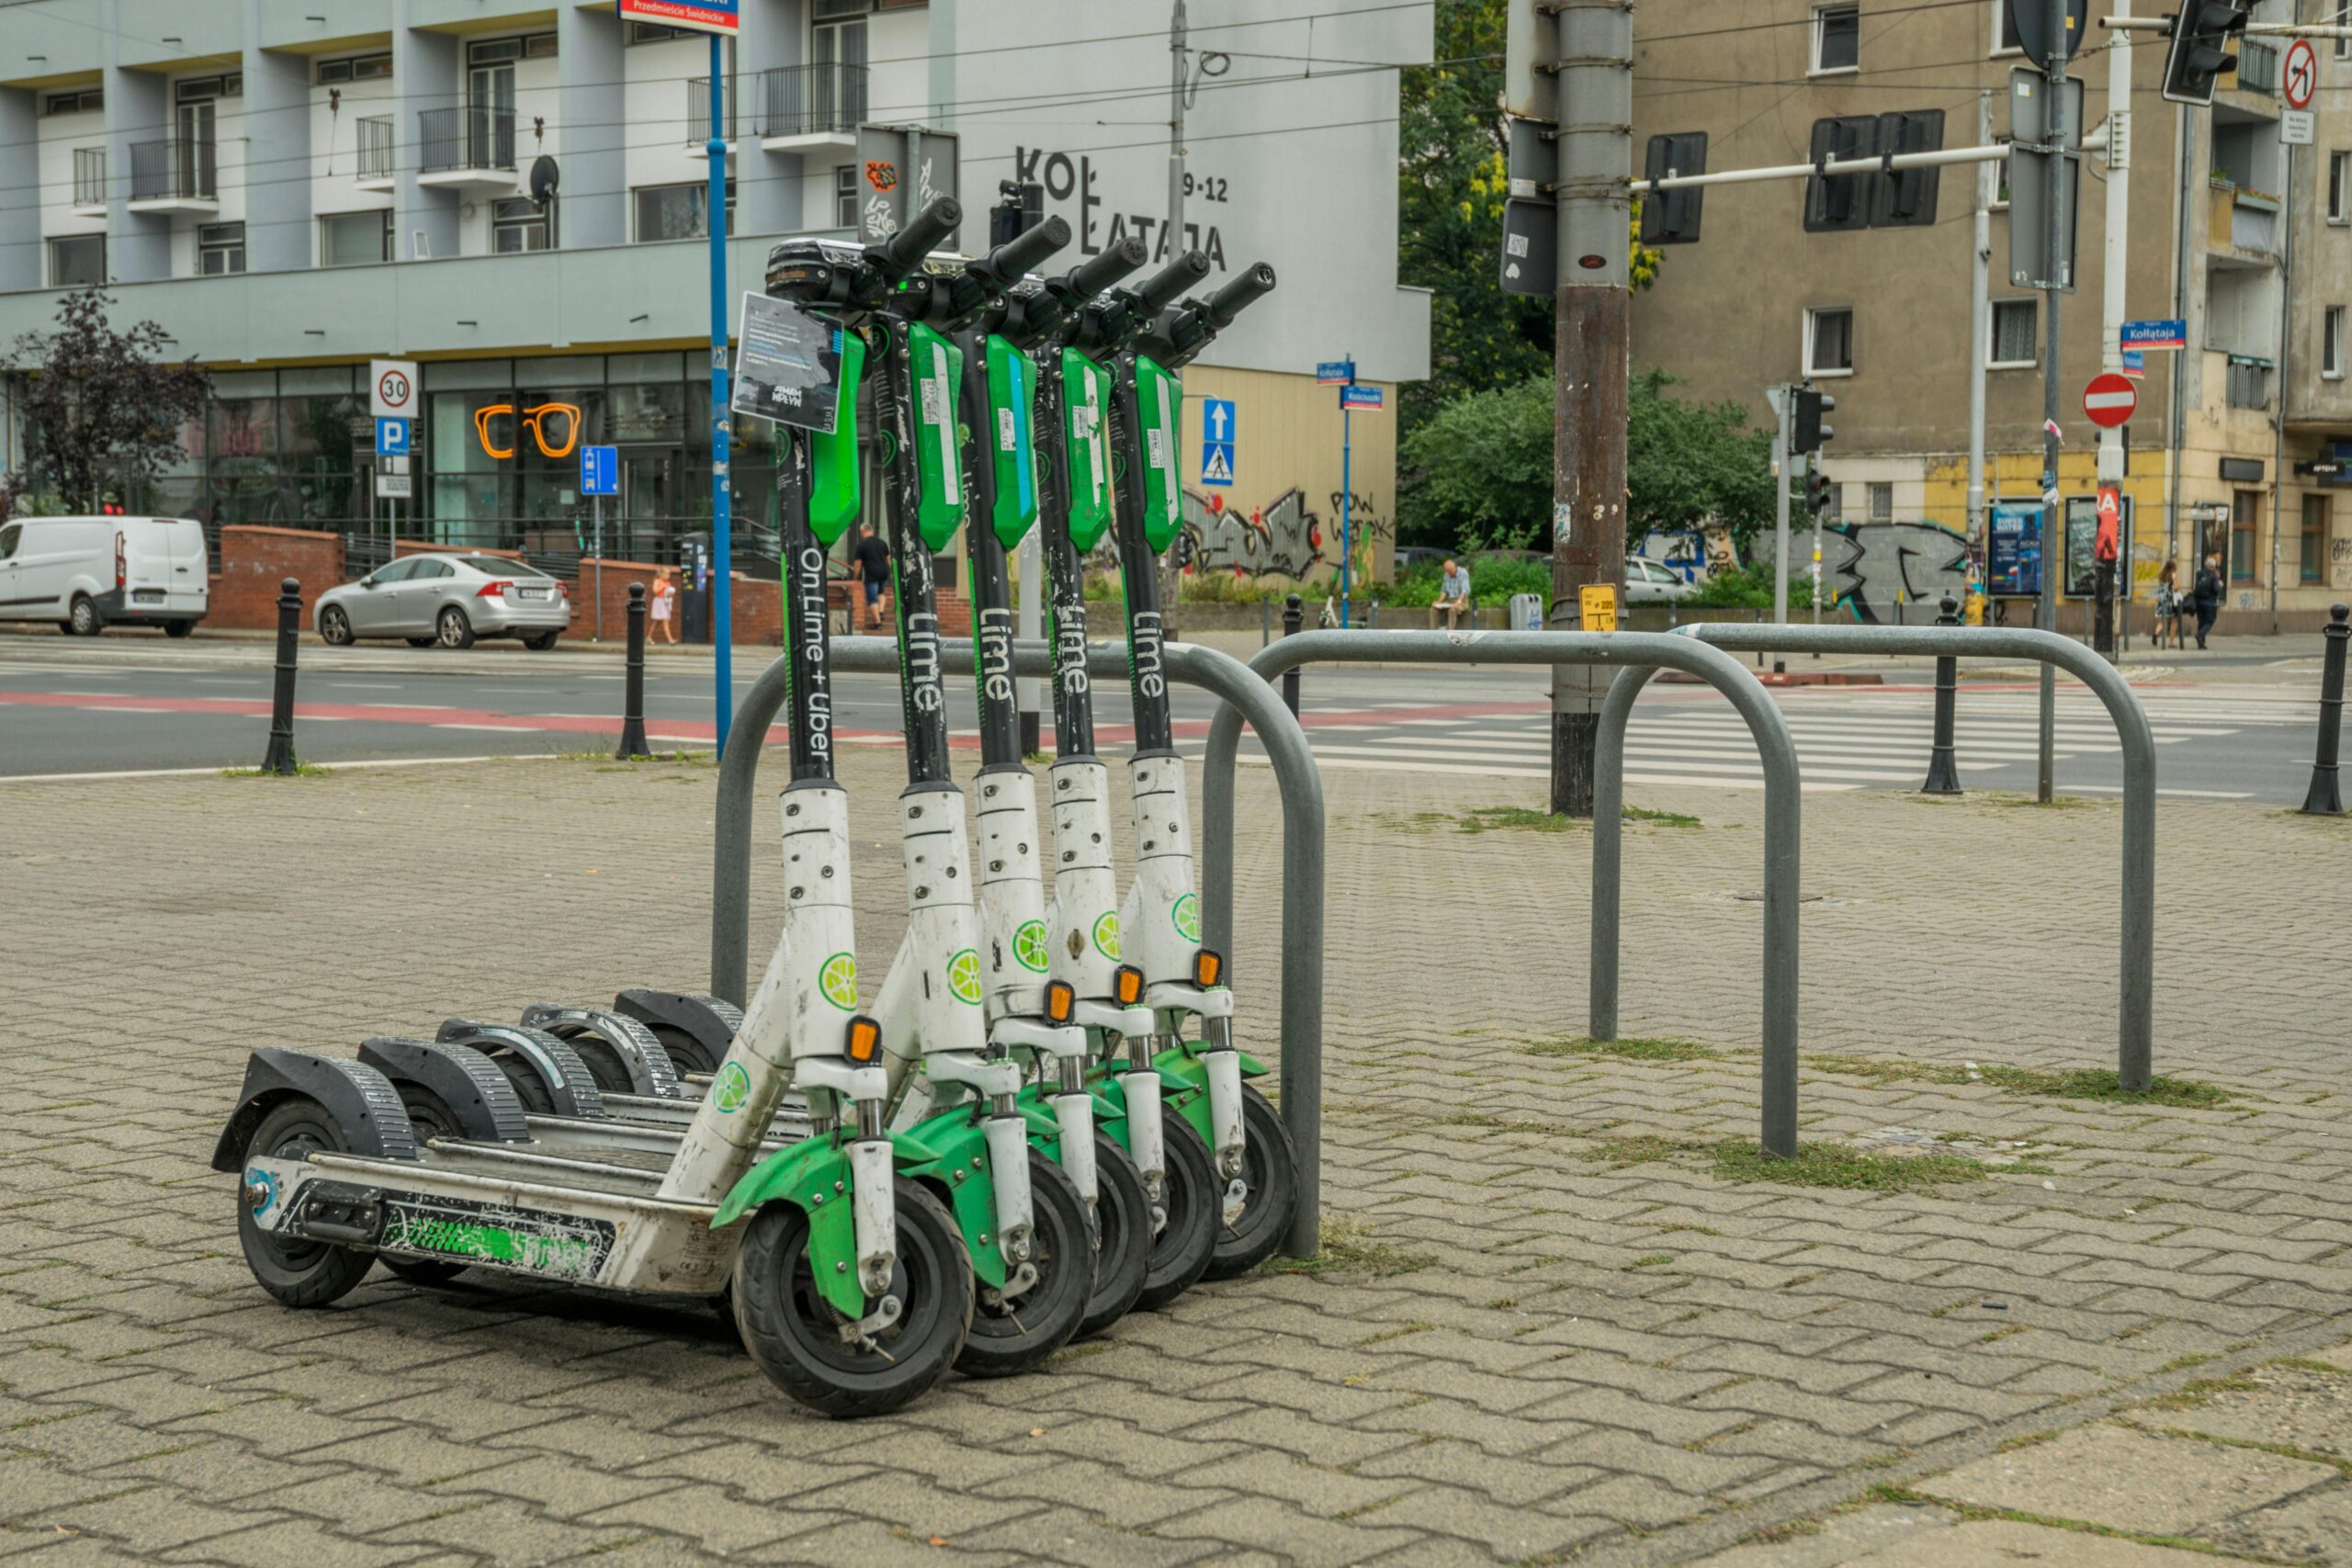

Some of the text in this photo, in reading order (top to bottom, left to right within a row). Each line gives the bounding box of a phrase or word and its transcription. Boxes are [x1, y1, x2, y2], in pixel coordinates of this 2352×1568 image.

[633, 1, 725, 23] Przedmieście Świdnickie
[2130, 327, 2176, 340] Kołłątaja
[384, 379, 406, 398] 30
[384, 422, 402, 451] P
[800, 547, 823, 588] On
[803, 595, 825, 662] Lime
[1601, 601, 1613, 610] 225
[908, 612, 943, 712] Lime
[979, 607, 1012, 700] Lime
[1058, 605, 1089, 694] Lime
[1134, 611, 1165, 698] Lime
[808, 693, 831, 761] Uber
